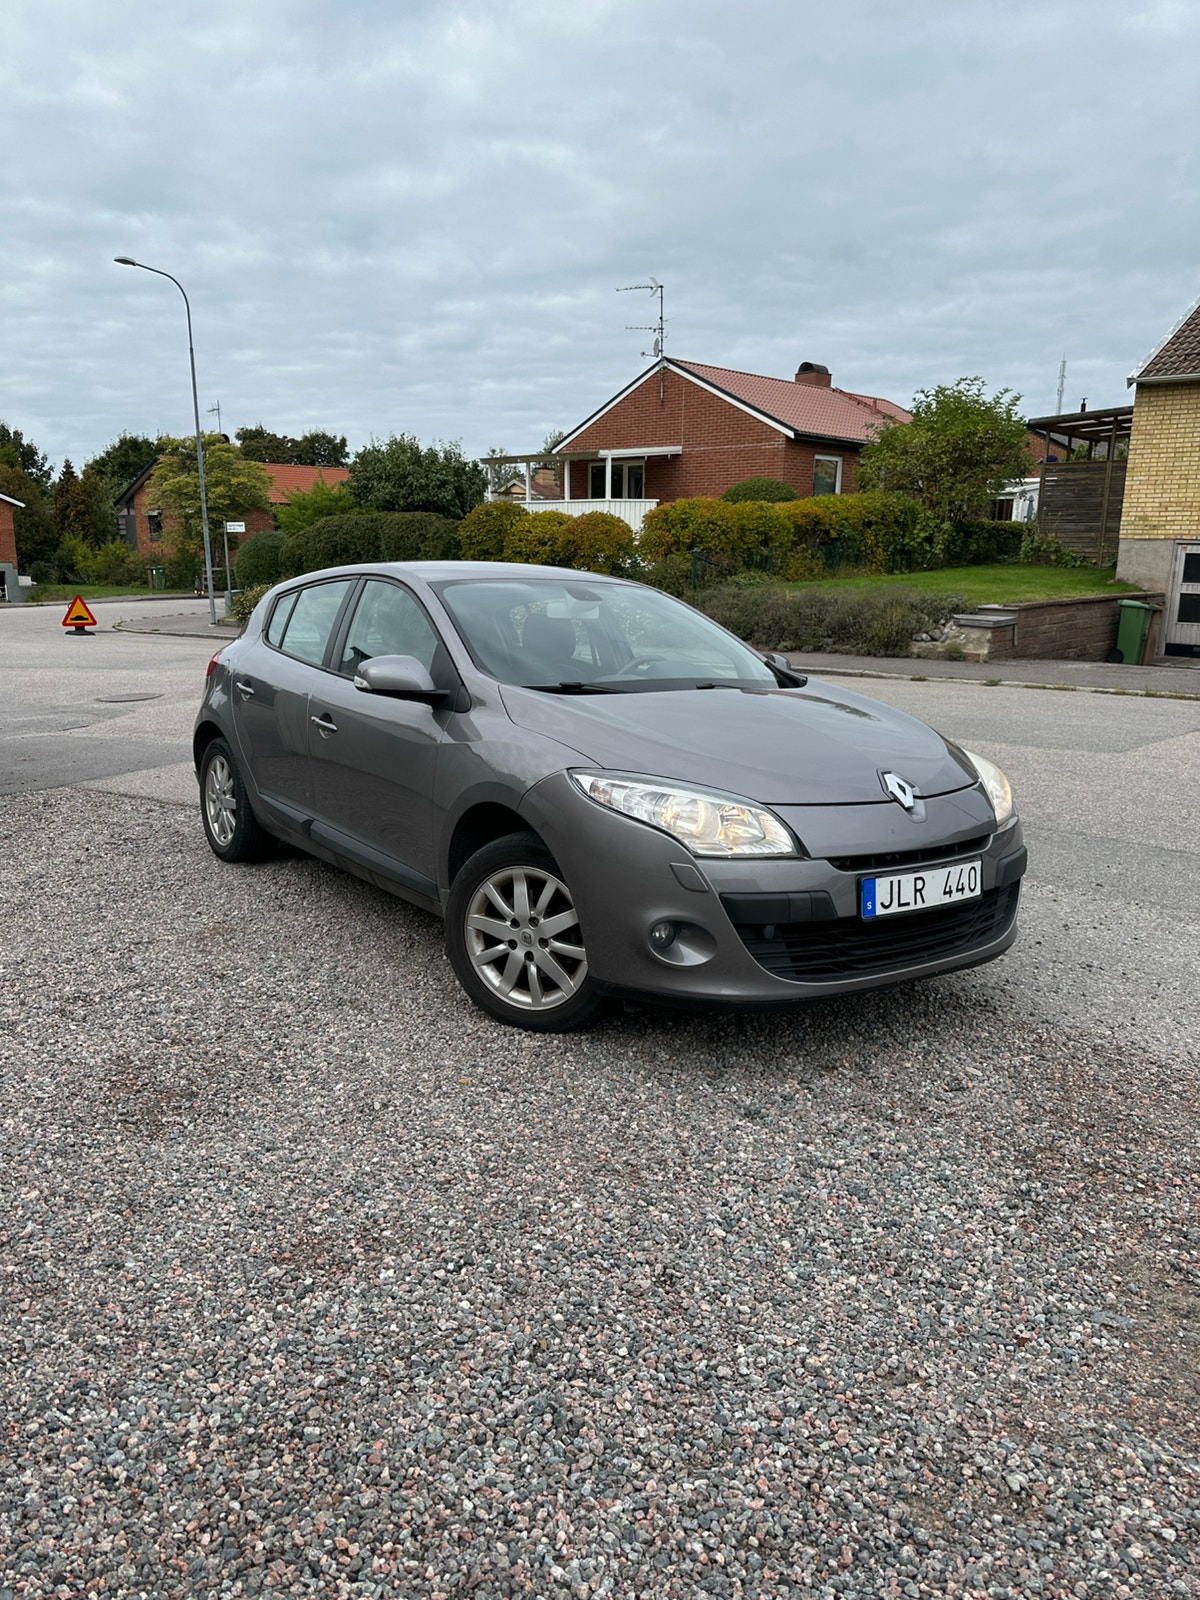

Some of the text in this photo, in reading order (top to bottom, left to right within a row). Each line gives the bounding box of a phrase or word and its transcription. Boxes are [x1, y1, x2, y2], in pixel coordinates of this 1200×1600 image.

[880, 866, 977, 909] JLR 440
[866, 901, 873, 910] S
